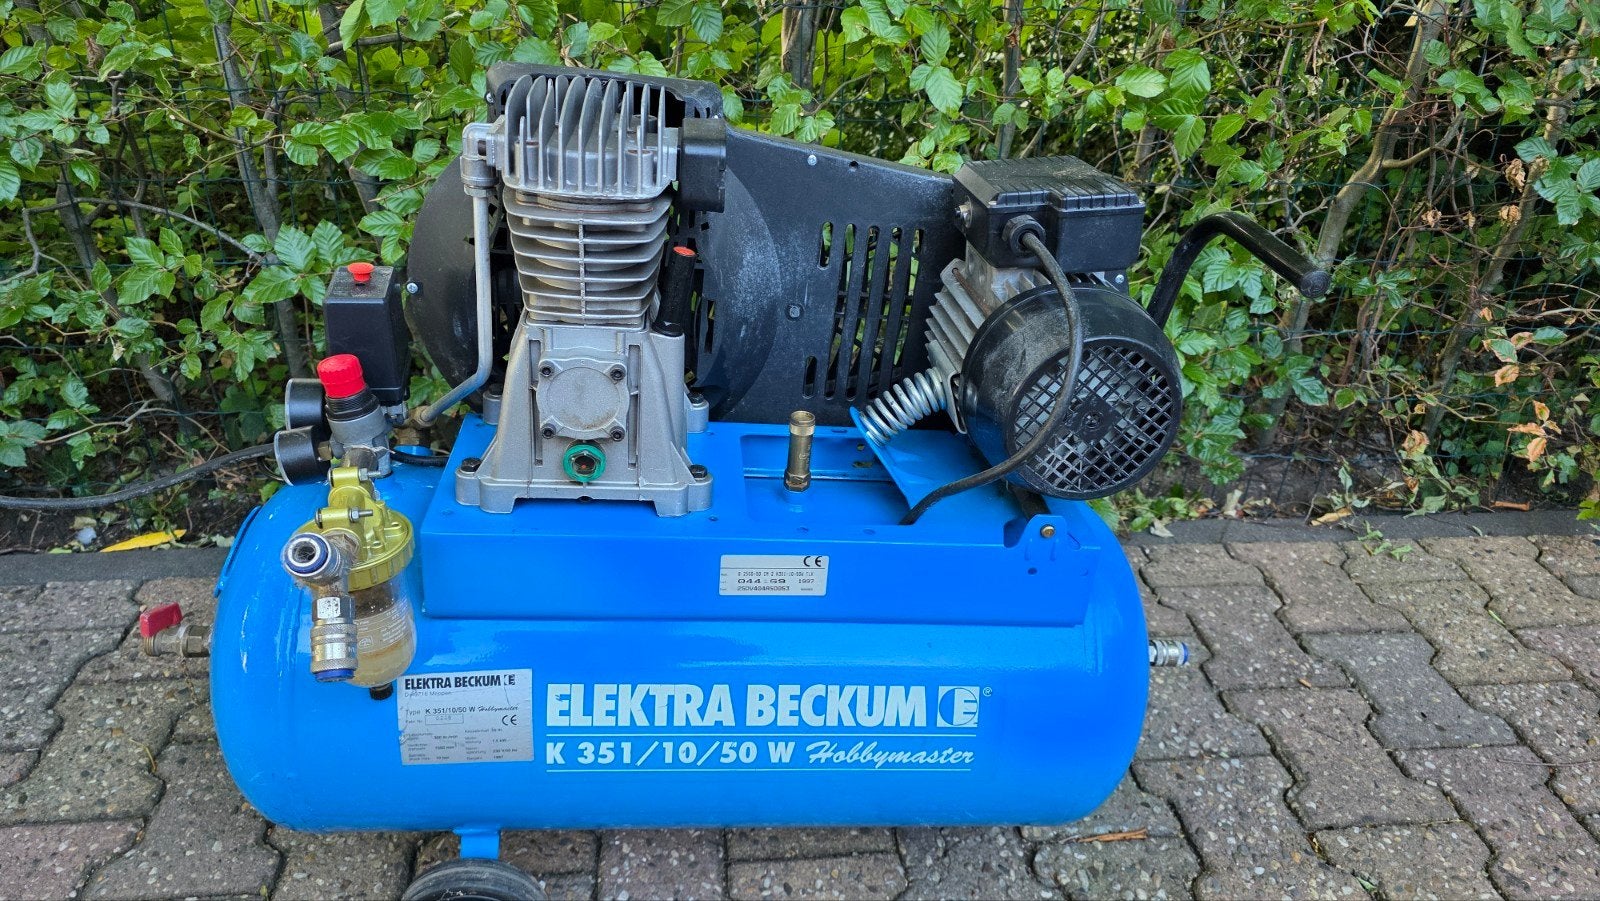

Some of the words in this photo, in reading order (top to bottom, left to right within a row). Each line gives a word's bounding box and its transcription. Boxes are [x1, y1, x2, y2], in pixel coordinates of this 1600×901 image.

[404, 676, 452, 690] ELEKTRA
[454, 674, 502, 688] BECKUM
[433, 706, 467, 715] 351/10/50
[546, 683, 736, 727] ELEKTRA
[745, 683, 927, 727] BECKUM
[546, 741, 566, 765] K
[577, 740, 758, 767] 351/10/50
[767, 741, 796, 764] W
[805, 740, 975, 769] Hobbymaster
